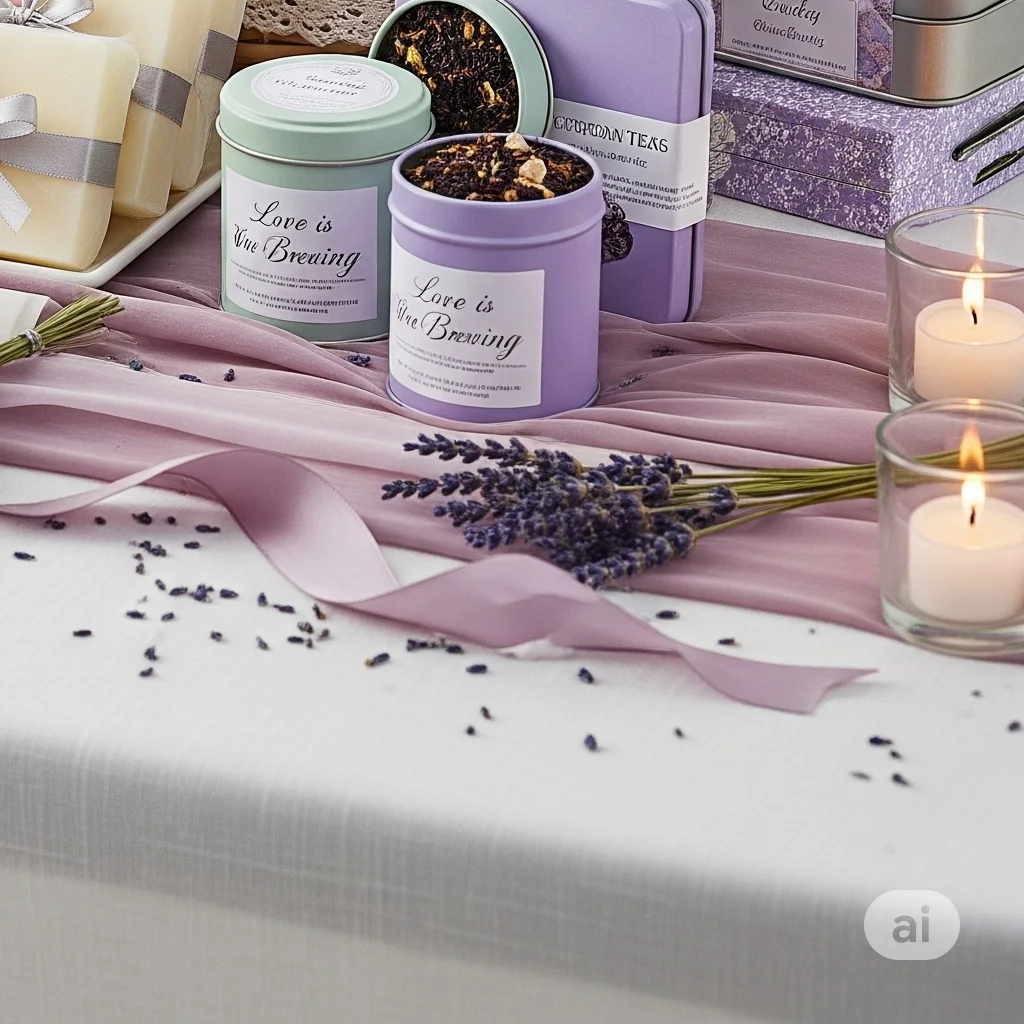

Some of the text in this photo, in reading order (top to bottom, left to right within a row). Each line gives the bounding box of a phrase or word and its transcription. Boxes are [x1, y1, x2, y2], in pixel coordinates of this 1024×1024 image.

[249, 200, 334, 234] Love is
[408, 275, 495, 314] Love is
